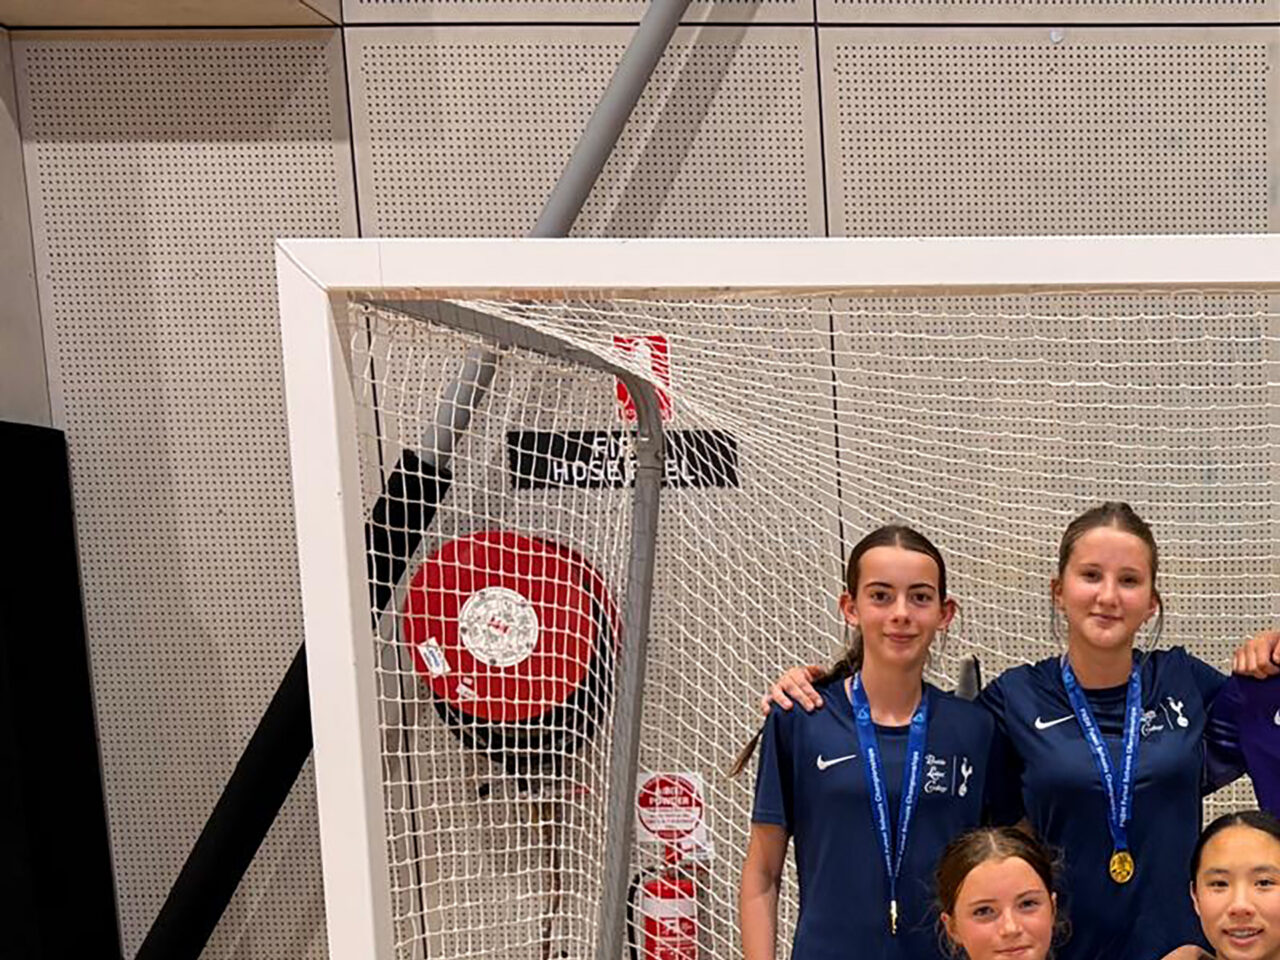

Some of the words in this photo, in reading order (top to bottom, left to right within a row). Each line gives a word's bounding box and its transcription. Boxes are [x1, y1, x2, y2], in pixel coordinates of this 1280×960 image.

[594, 437, 649, 458] FIR
[553, 460, 622, 480] HOSE
[629, 460, 696, 480] REL
